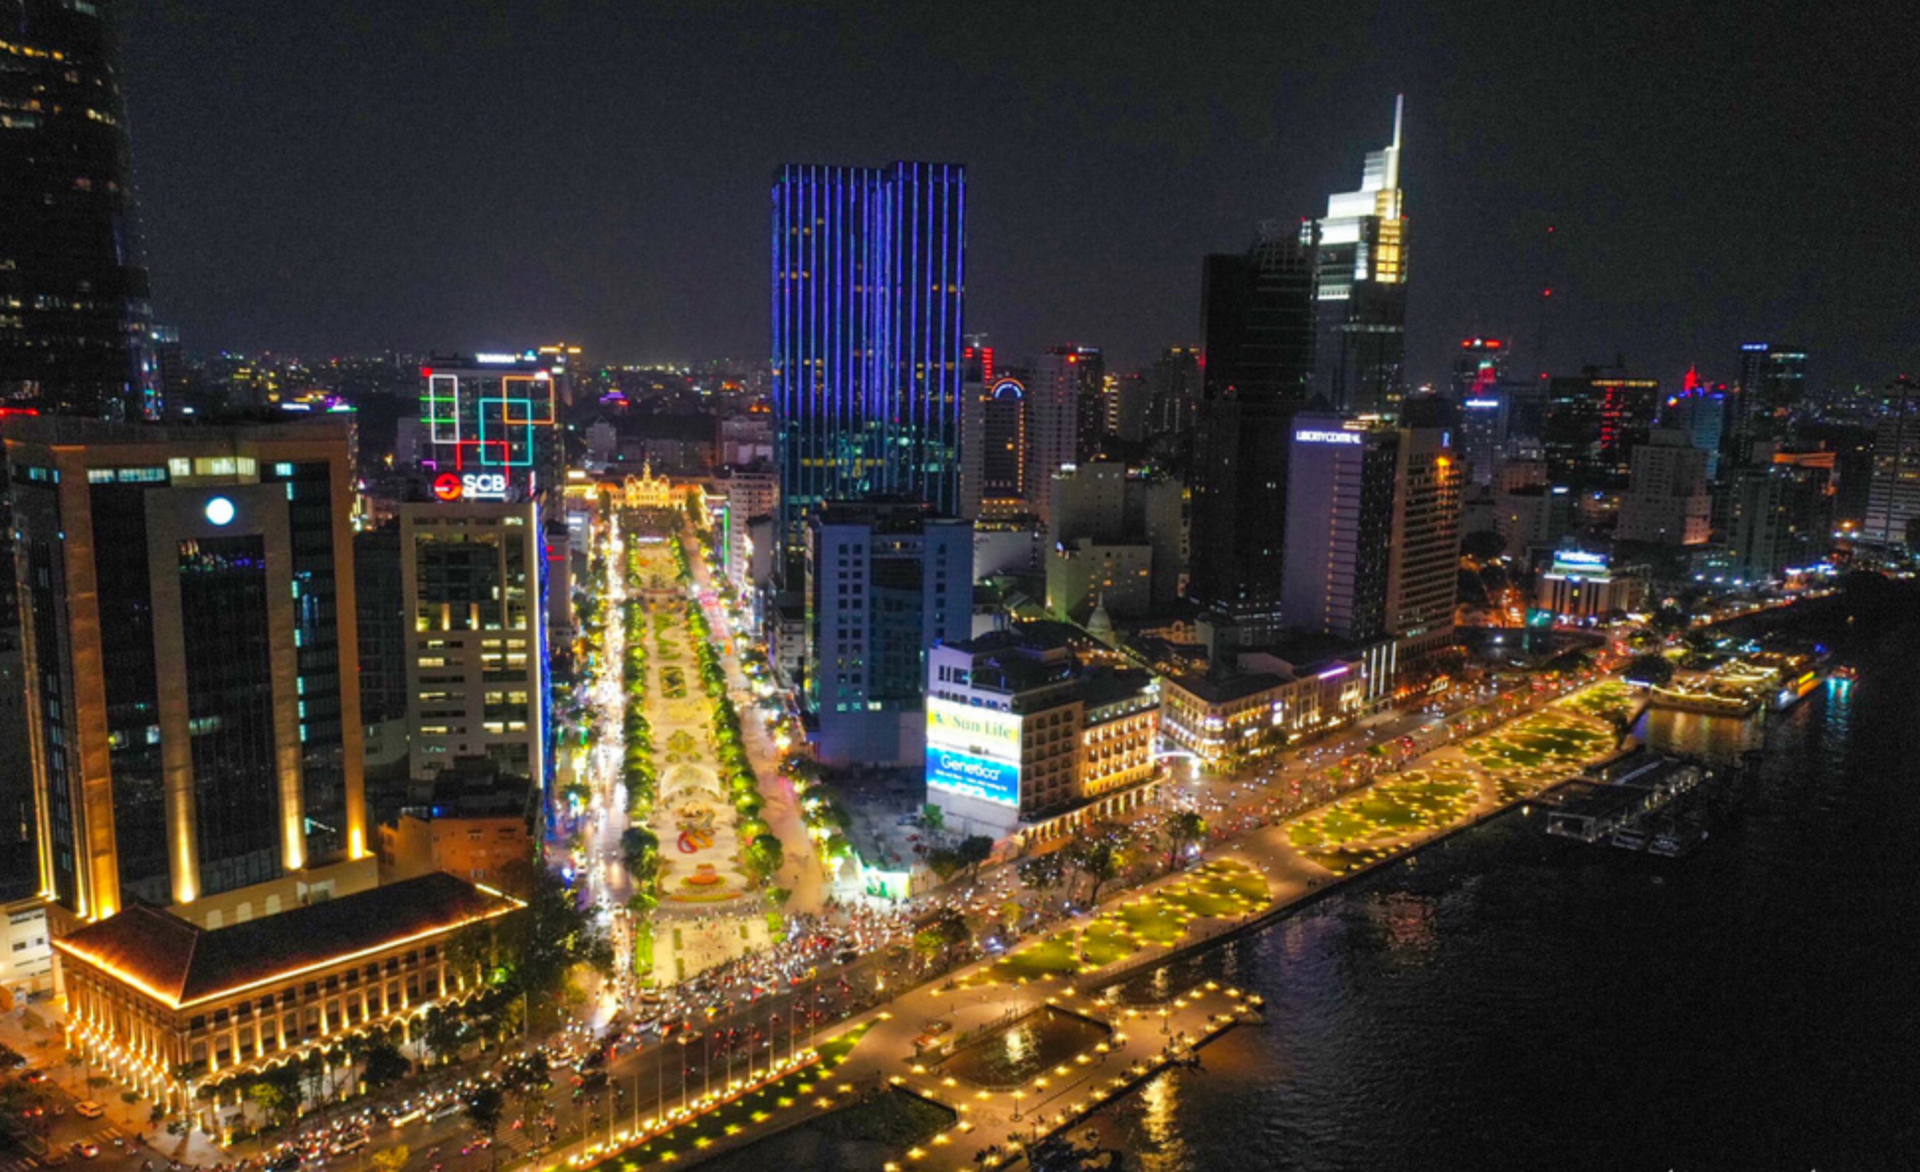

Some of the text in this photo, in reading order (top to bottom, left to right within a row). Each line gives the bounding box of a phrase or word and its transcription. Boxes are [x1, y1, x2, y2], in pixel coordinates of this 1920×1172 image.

[462, 474, 505, 491] SCB
[953, 715, 1012, 739] Sun Life
[940, 754, 1000, 781] Genetica
